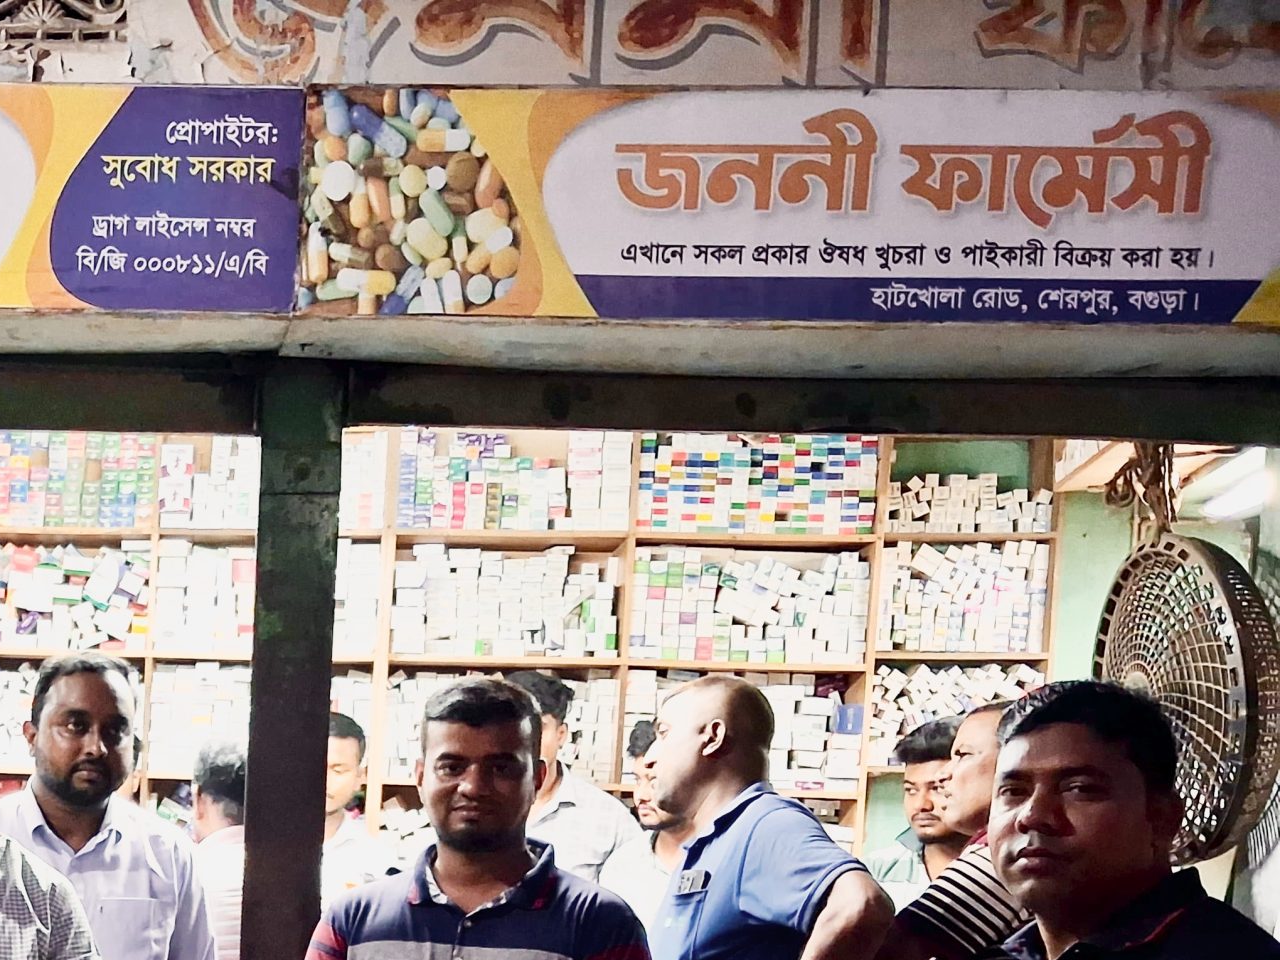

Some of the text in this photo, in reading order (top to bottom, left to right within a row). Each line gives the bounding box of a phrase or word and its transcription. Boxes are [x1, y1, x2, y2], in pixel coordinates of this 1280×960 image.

[101, 153, 276, 189] সুবোধ সরকার
[615, 107, 1216, 230] জননী ফার্মেসী
[92, 210, 256, 239] ড্রাগ লাইসেন্স নম্বর
[76, 245, 269, 278] বি/জি ০০০৮১১/এ/বি
[621, 242, 686, 265] এখানে
[693, 244, 746, 265] সকল
[752, 243, 810, 265] প্রকার
[819, 238, 867, 266] ঔষধ
[876, 243, 925, 271] খুচরা
[934, 246, 951, 264] ও
[961, 239, 1047, 269] পাইকারী
[1053, 240, 1115, 268] বিক্রয়
[1120, 246, 1163, 269] করা
[870, 281, 966, 310] হাটখোলা
[972, 287, 1028, 314] রোড,
[1038, 288, 1119, 316] শেরপুর,
